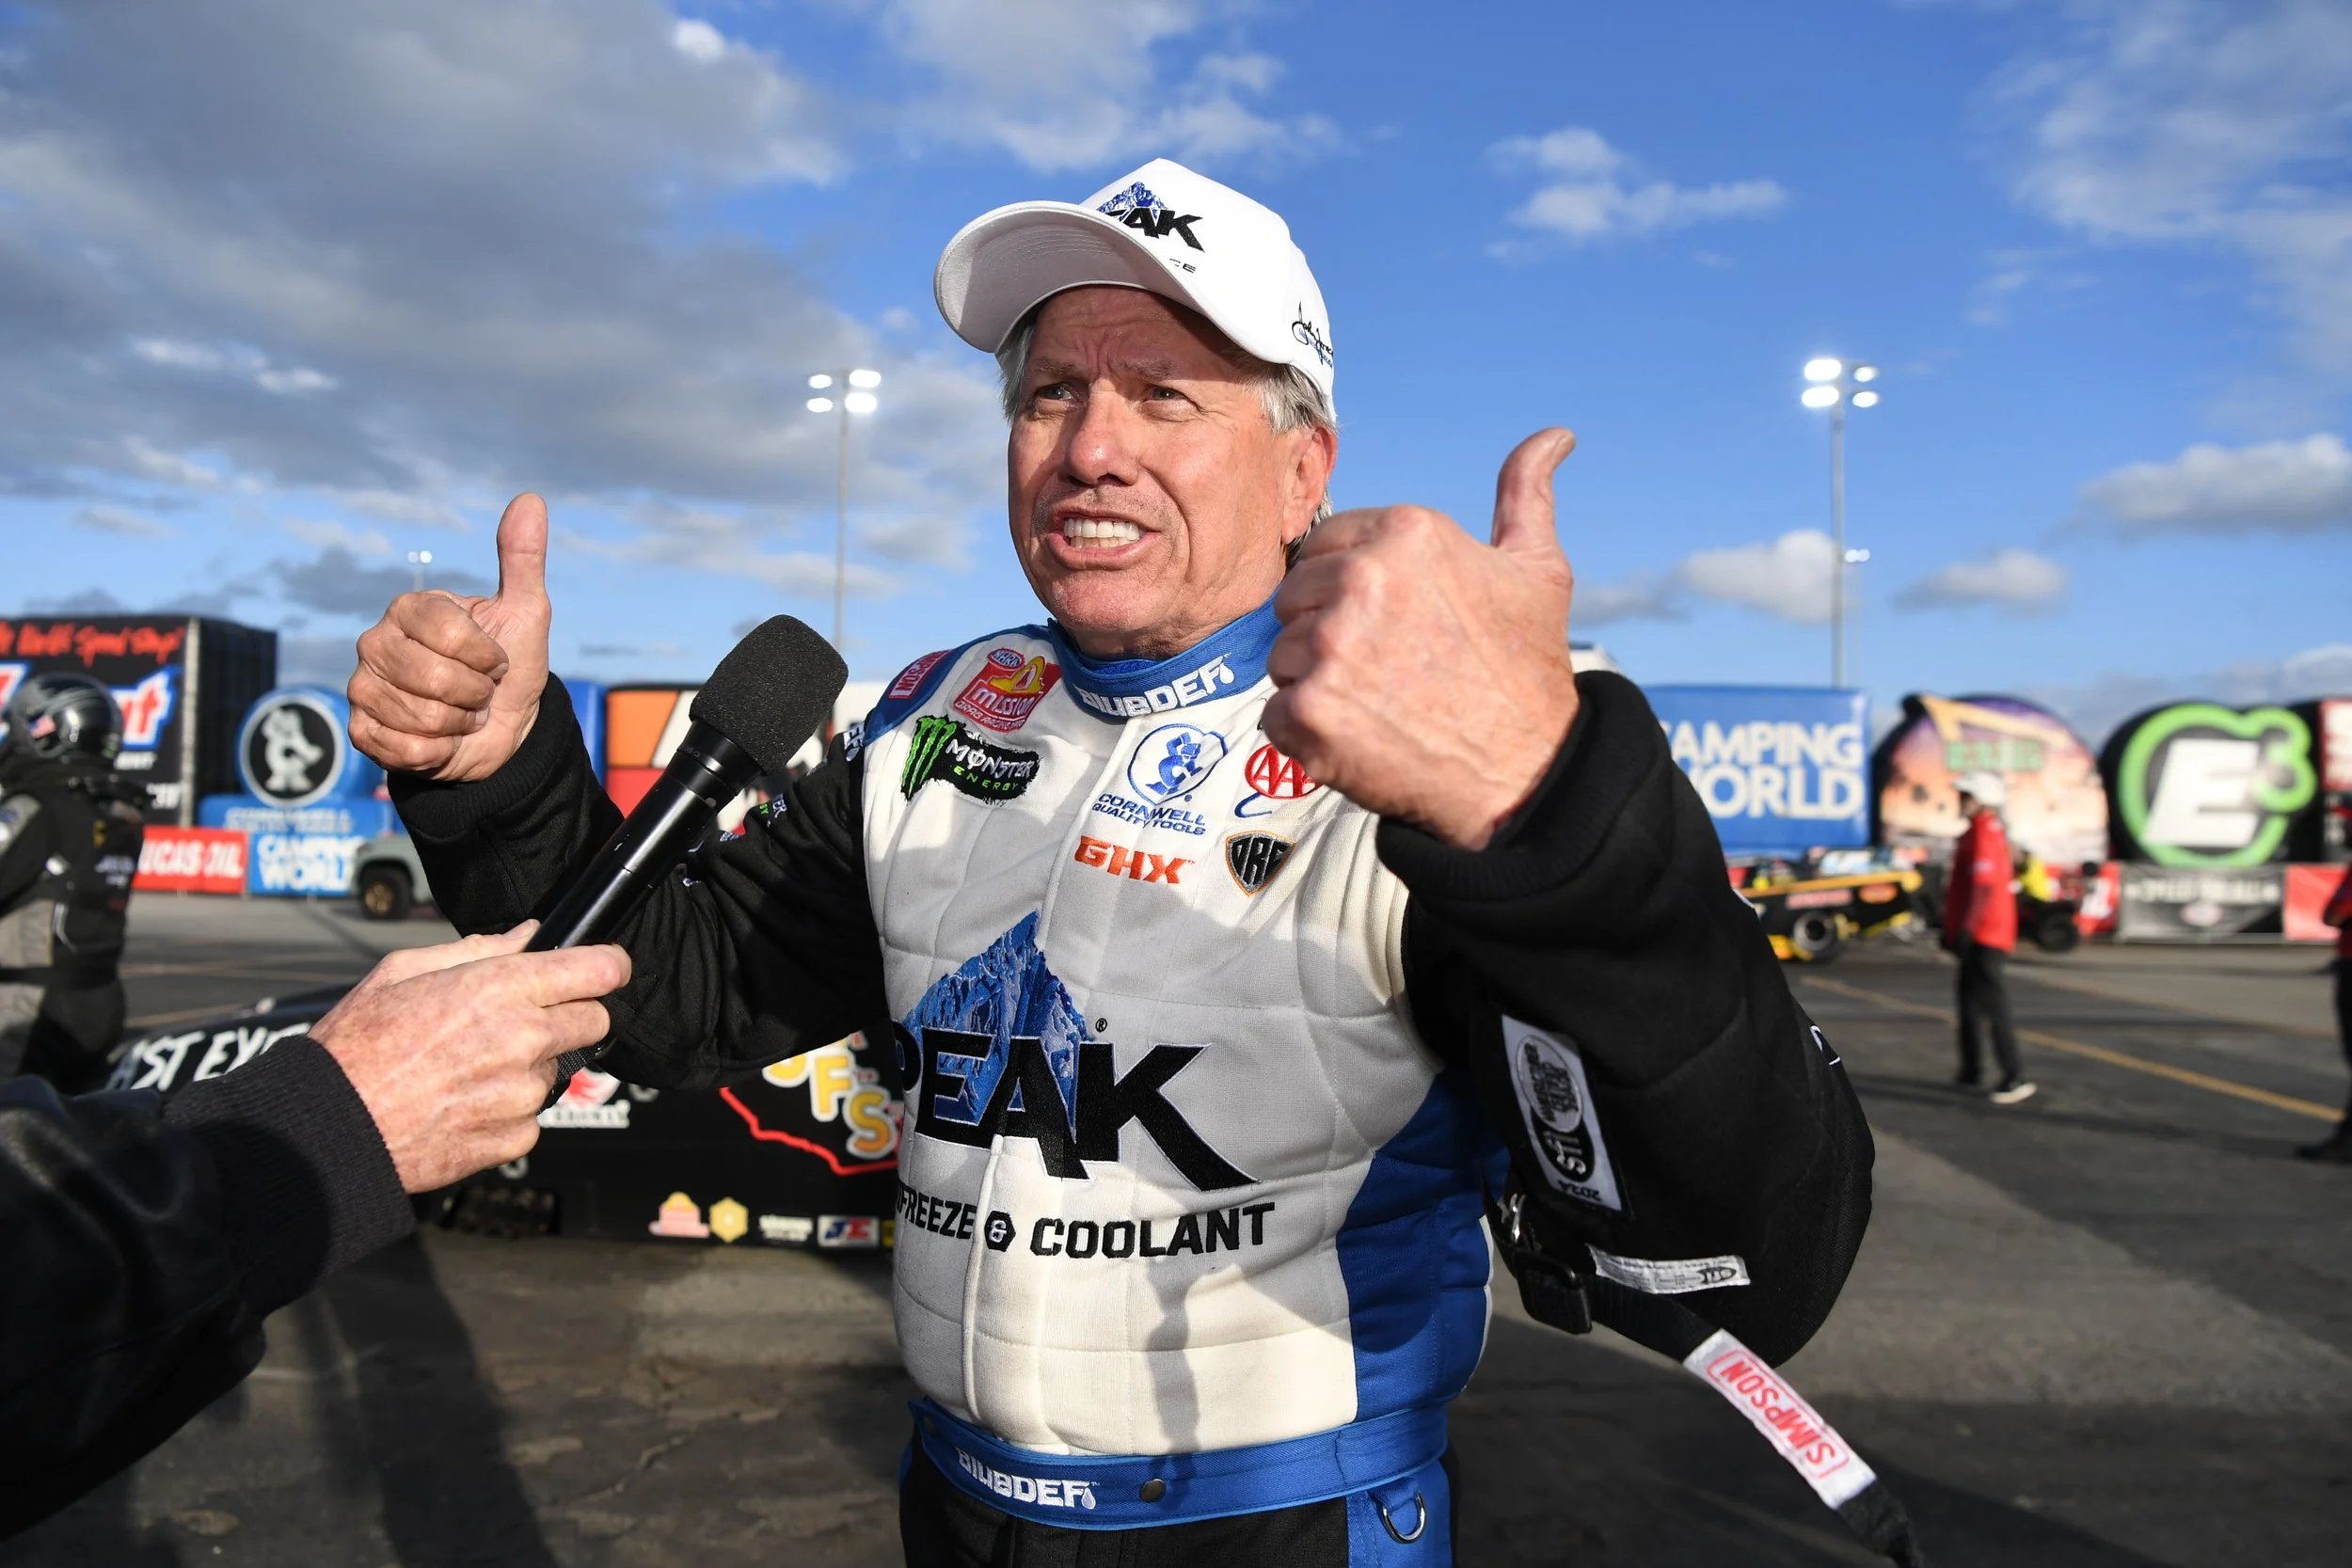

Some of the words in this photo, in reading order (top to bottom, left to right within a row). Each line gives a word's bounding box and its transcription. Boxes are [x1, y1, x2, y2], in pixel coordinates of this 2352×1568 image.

[1104, 207, 1205, 253] AK
[993, 650, 1021, 667] NHRA
[1659, 721, 1864, 771] AMPING
[953, 765, 1019, 791] ENERGY
[1253, 745, 1315, 798] AA
[1688, 763, 1867, 821] ORLD
[1091, 802, 1151, 829] QUALITY
[1152, 817, 1206, 836] TOOLS
[1098, 793, 1206, 826] CORNWELL
[137, 839, 202, 877] UCAS
[259, 859, 358, 891] WORL
[1074, 835, 1188, 884] GHX
[897, 1181, 977, 1240] FREEZE
[1029, 1202, 1276, 1259] COOLANT
[1719, 1360, 1836, 1467] SIMPSON
